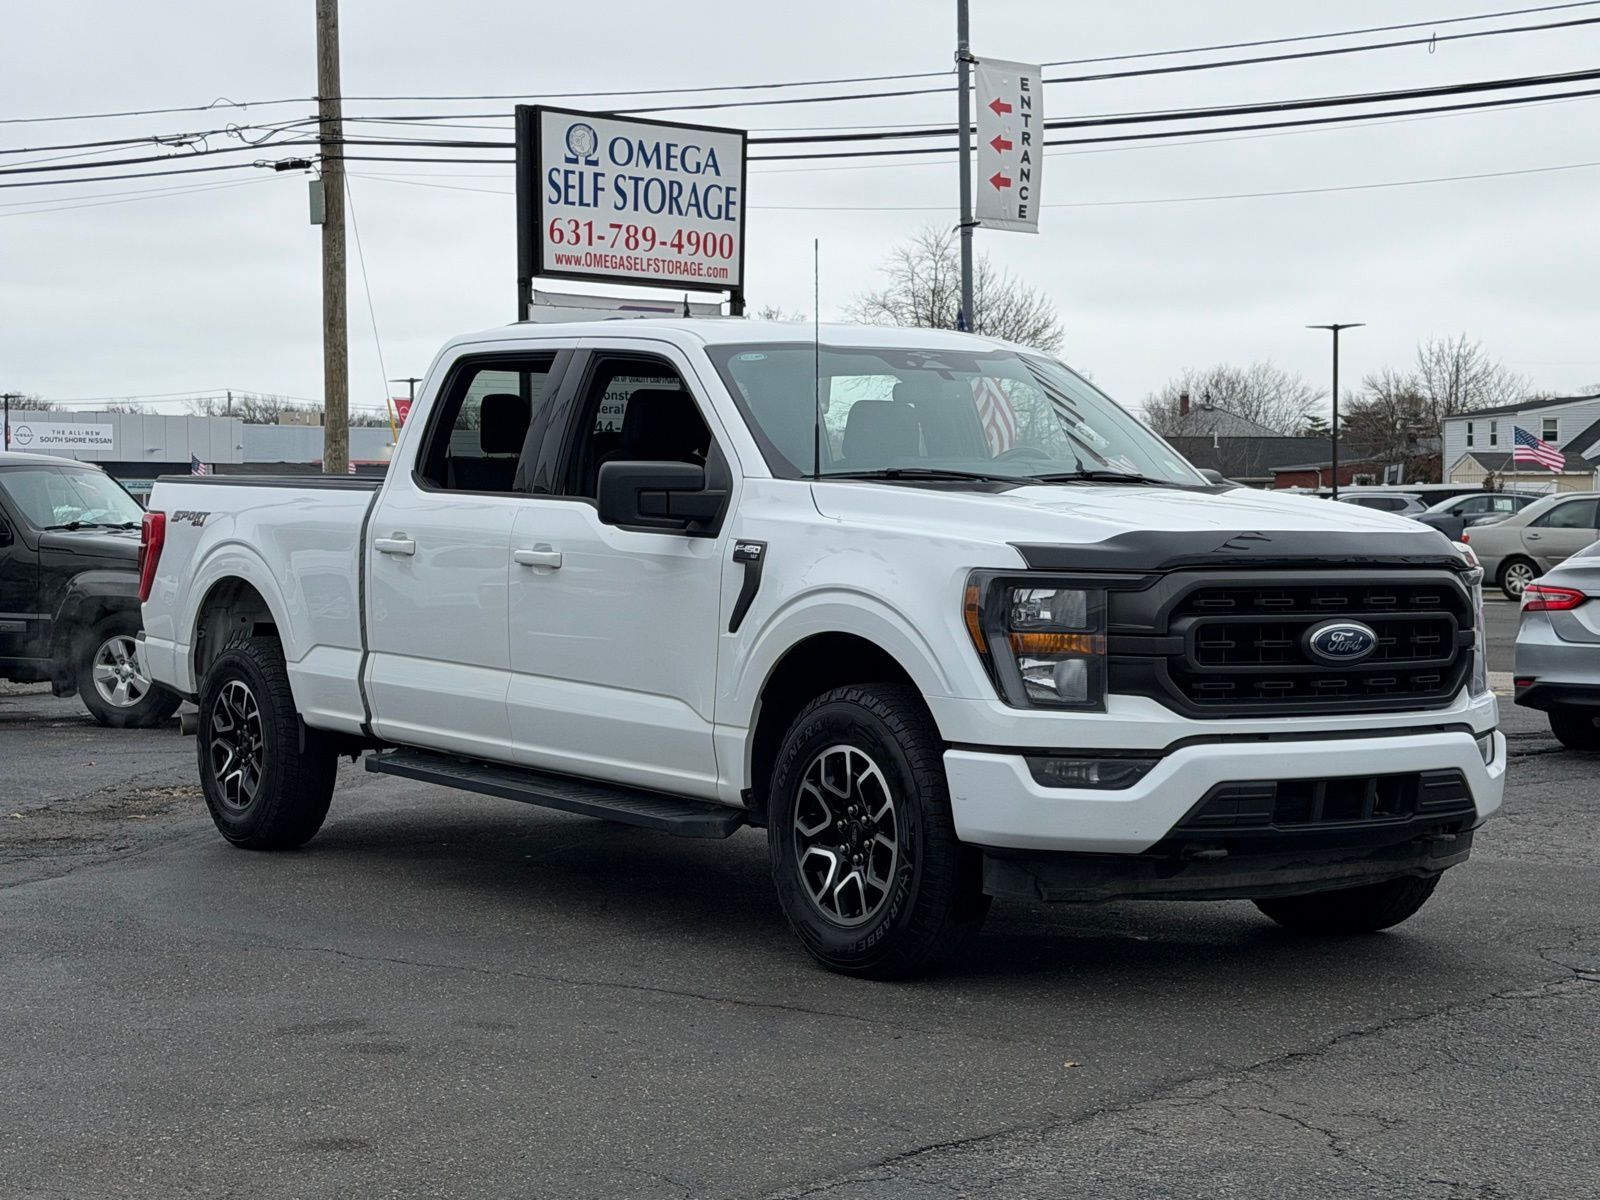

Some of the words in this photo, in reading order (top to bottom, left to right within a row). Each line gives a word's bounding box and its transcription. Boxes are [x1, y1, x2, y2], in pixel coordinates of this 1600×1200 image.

[608, 136, 721, 177] OMEGA
[1018, 77, 1031, 219] ENTRANCE
[547, 167, 606, 208] SELF
[613, 174, 737, 222] STORAGE
[549, 217, 734, 260] 631-789-4900
[601, 403, 624, 414] eral
[170, 510, 211, 527] SPORT
[735, 545, 762, 554] F-150
[1327, 631, 1363, 652] Ford
[847, 888, 904, 953] GRABBER
